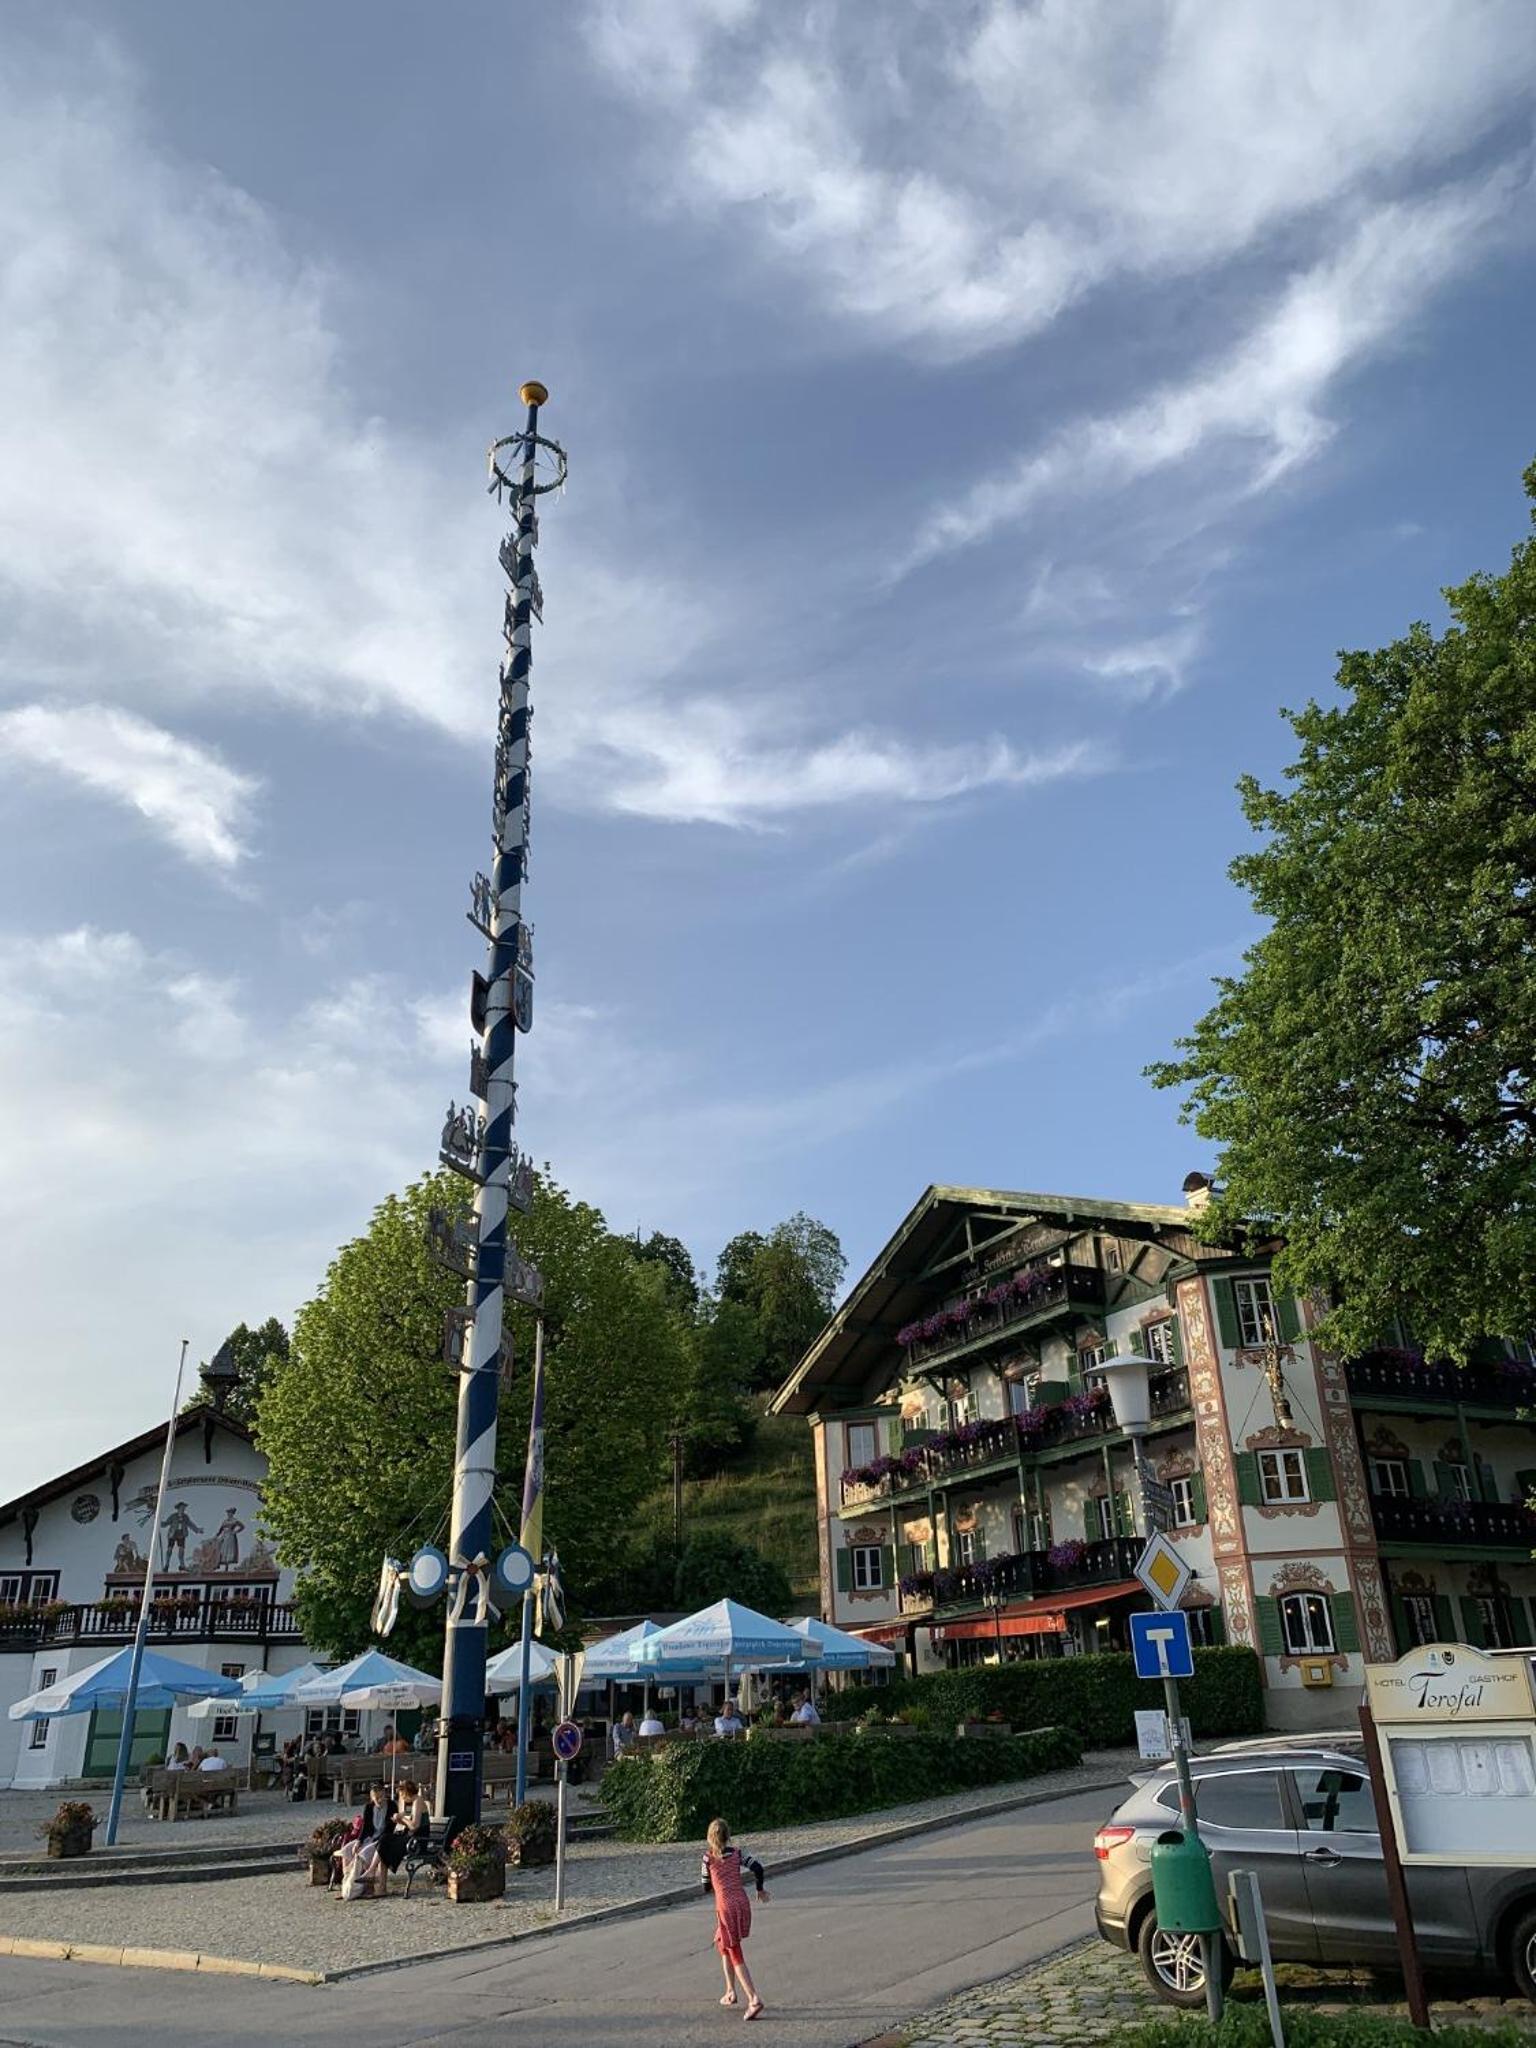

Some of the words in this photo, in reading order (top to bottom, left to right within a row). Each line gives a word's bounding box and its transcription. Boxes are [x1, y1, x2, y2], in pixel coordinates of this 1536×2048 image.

[1374, 1678, 1406, 1688] HOTEL
[1468, 1673, 1519, 1684] GASTHOF
[1408, 1671, 1484, 1715] Terofal
